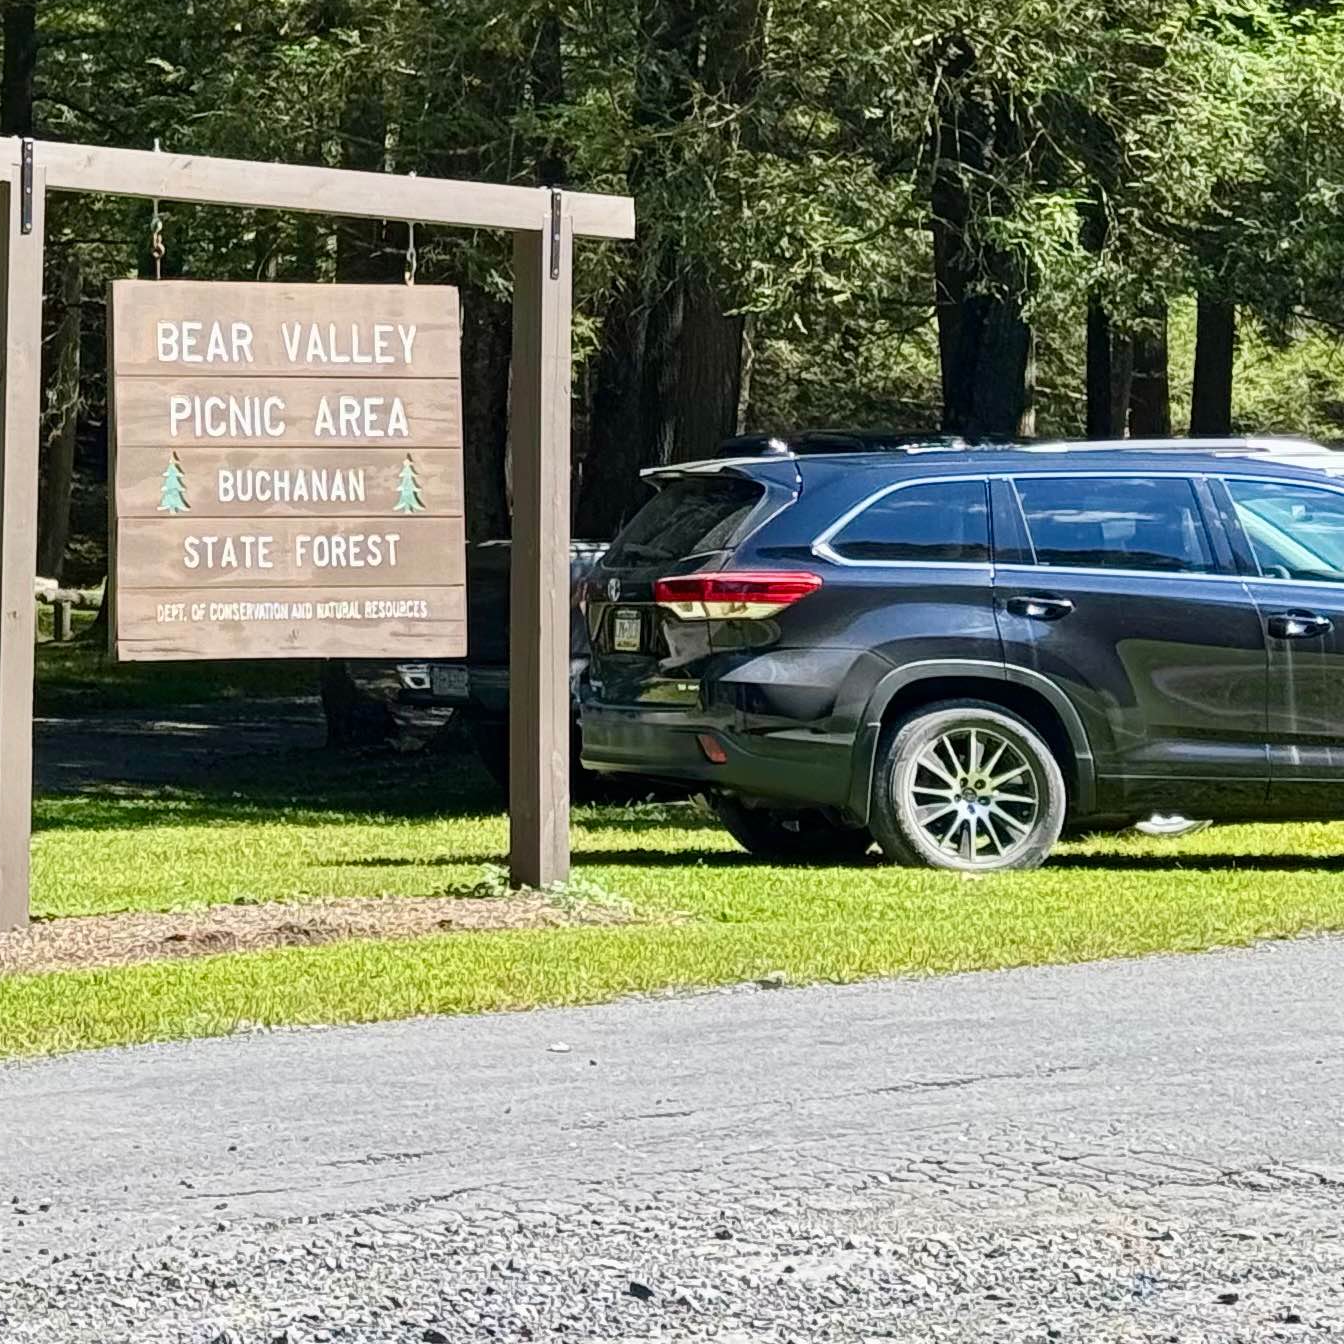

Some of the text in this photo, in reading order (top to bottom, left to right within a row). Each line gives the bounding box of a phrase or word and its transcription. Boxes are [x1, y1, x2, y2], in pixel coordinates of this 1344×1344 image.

[157, 321, 417, 364] BEAR VALLEY
[170, 395, 409, 437] PICNIC AREA
[218, 469, 365, 502] BUCHANAN
[184, 534, 400, 568] STATE FOREST
[157, 600, 428, 622] DEPT. OF CONSERVATION AND NATURAL RESOURCES
